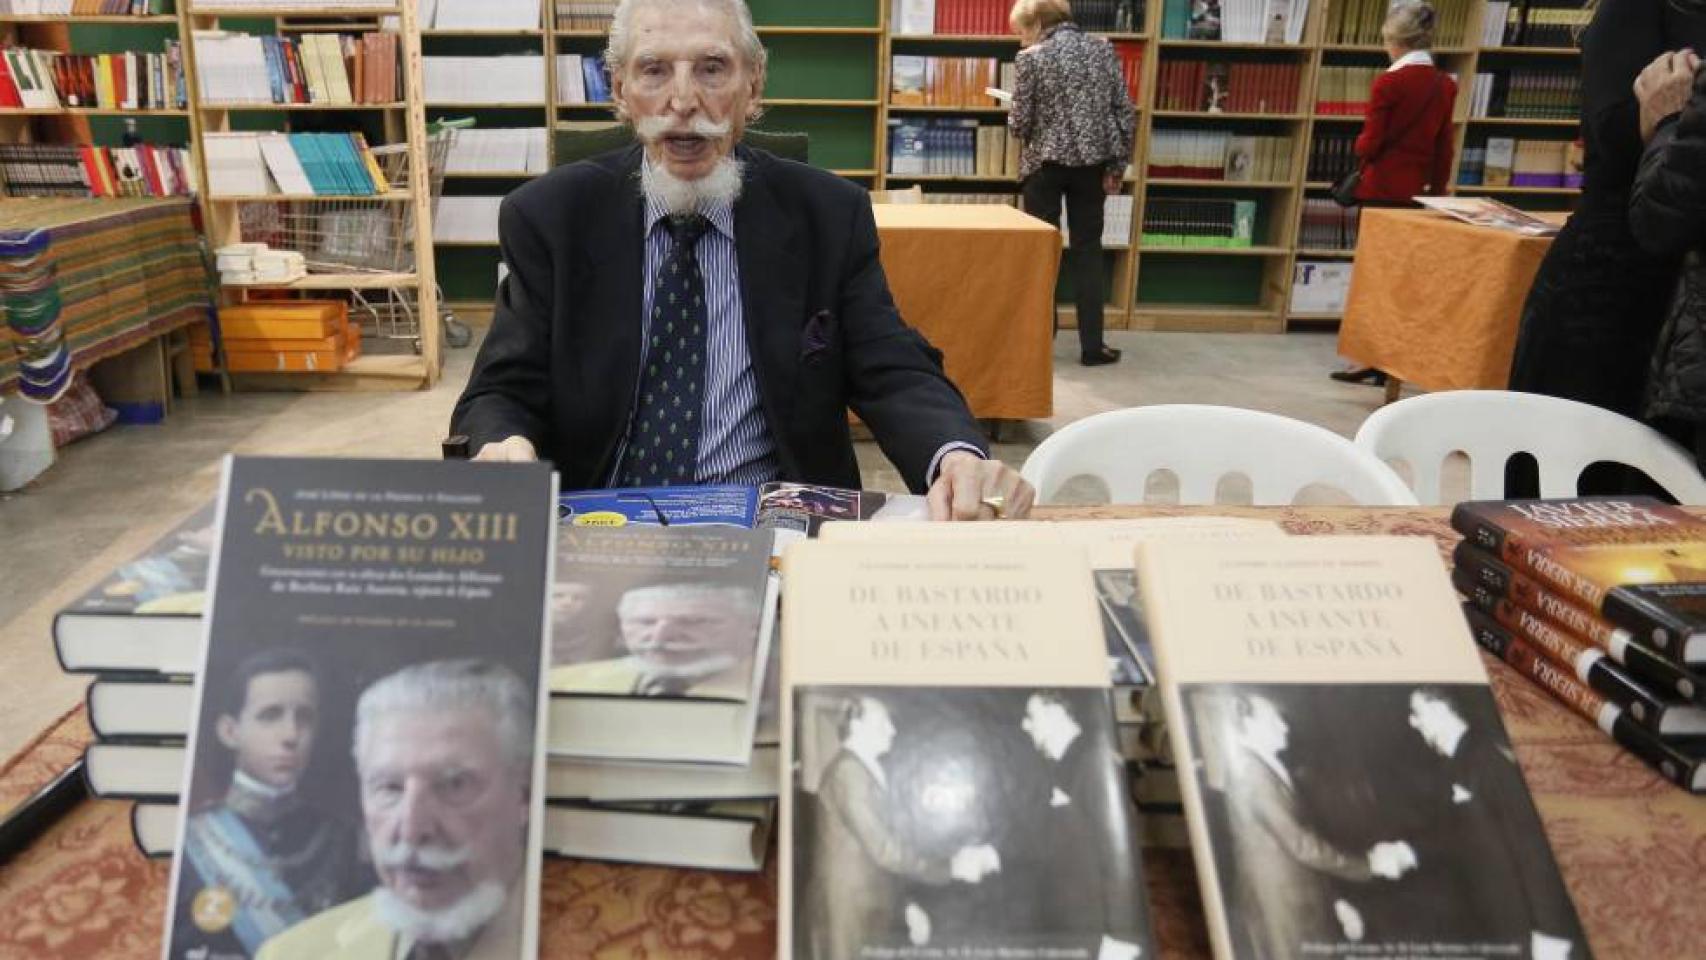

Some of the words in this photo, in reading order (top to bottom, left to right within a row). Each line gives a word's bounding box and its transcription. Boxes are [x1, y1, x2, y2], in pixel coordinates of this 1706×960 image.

[245, 488, 438, 540] ALFONSO
[449, 512, 518, 541] XIII
[283, 544, 343, 561] VISTO
[351, 545, 391, 562] POR
[398, 546, 425, 563] SU
[431, 547, 486, 565] HIJO
[849, 584, 883, 604] DE
[896, 584, 1044, 604] BASTARDO
[1211, 583, 1248, 601] DE
[1259, 582, 1405, 602] BASTARDO
[875, 612, 891, 632] A
[901, 612, 1021, 633] INFANTE
[1246, 609, 1262, 629] A
[1269, 609, 1389, 629] INFANTE
[870, 640, 904, 661] DE
[920, 639, 1031, 662] ESPAÑA
[1245, 637, 1282, 657] DE
[1294, 636, 1405, 658] ESPAÑA
